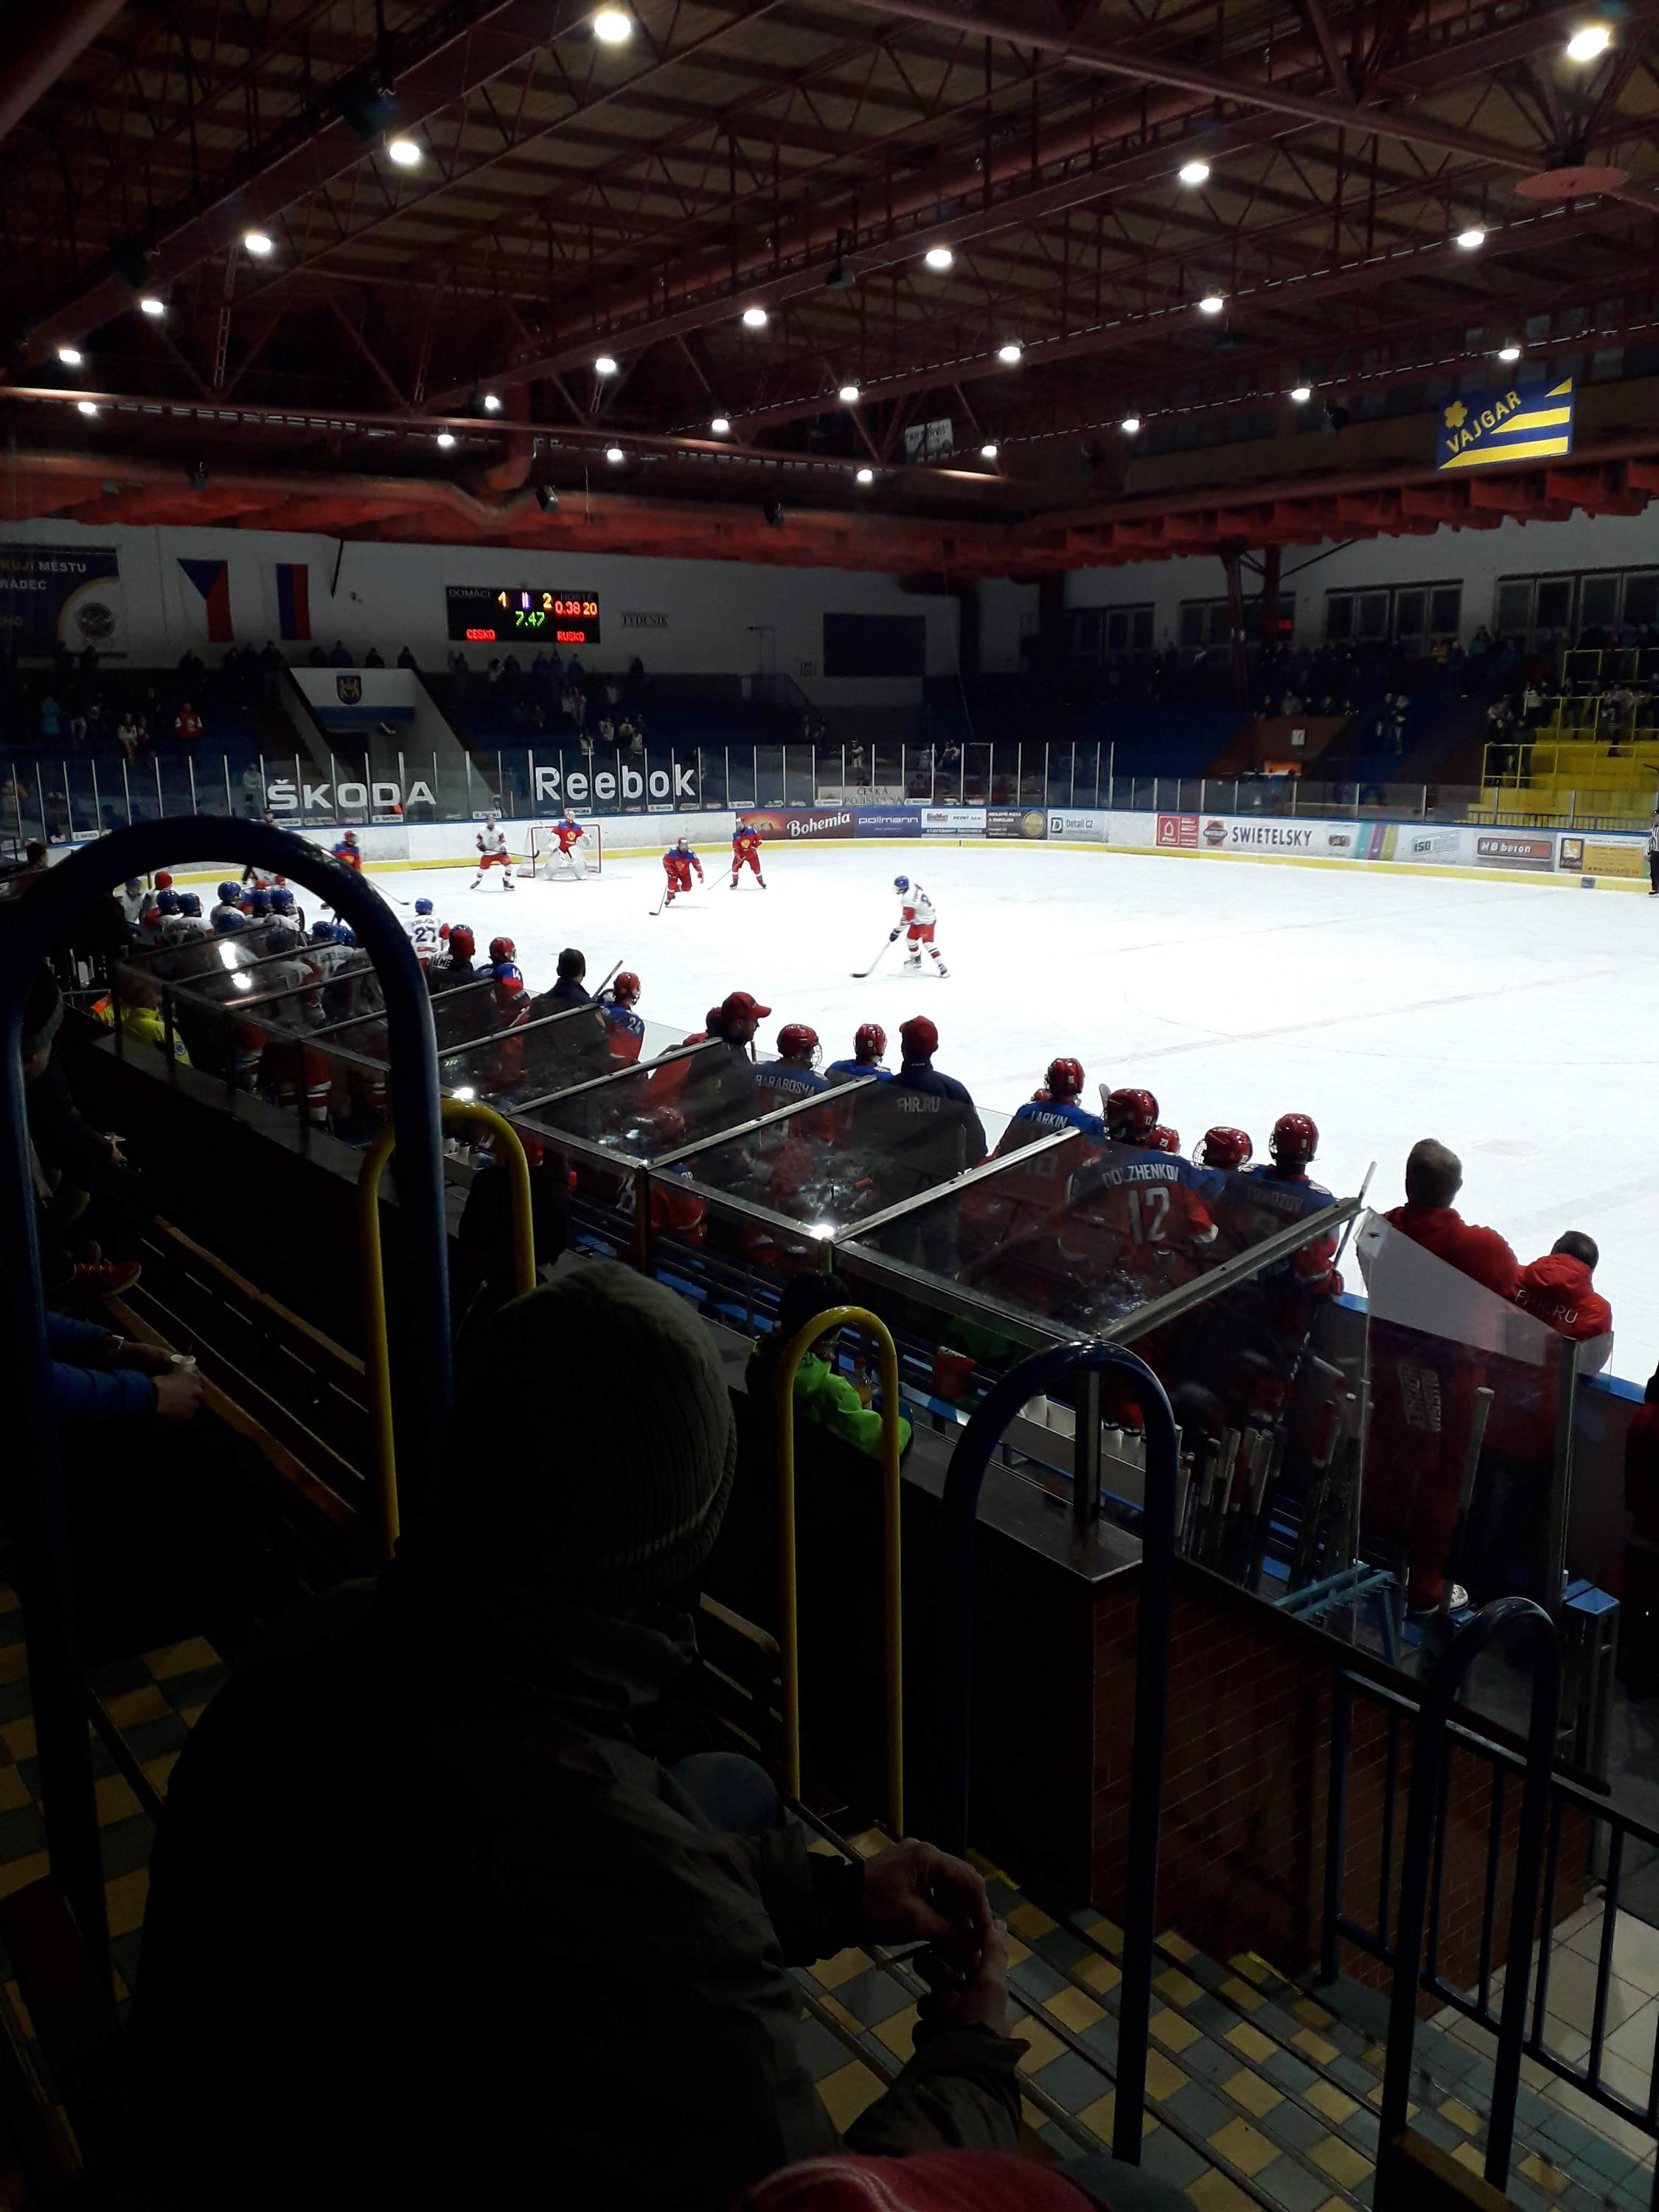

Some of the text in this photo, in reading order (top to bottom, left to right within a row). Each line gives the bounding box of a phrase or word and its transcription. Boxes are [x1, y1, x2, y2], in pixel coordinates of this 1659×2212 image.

[1446, 391, 1521, 453] VAJGAR
[543, 593, 552, 608] 2
[583, 602, 597, 615] 20
[557, 631, 585, 641] RUSKO
[535, 764, 696, 801] Reebok
[267, 779, 437, 810] ŠKODA
[786, 812, 851, 838] Bohemia
[858, 816, 919, 825] pollmann
[1232, 826, 1312, 846] SWIETELSKY
[1481, 841, 1499, 851] HB
[626, 1016, 641, 1034] 24
[1126, 1186, 1170, 1246] 12
